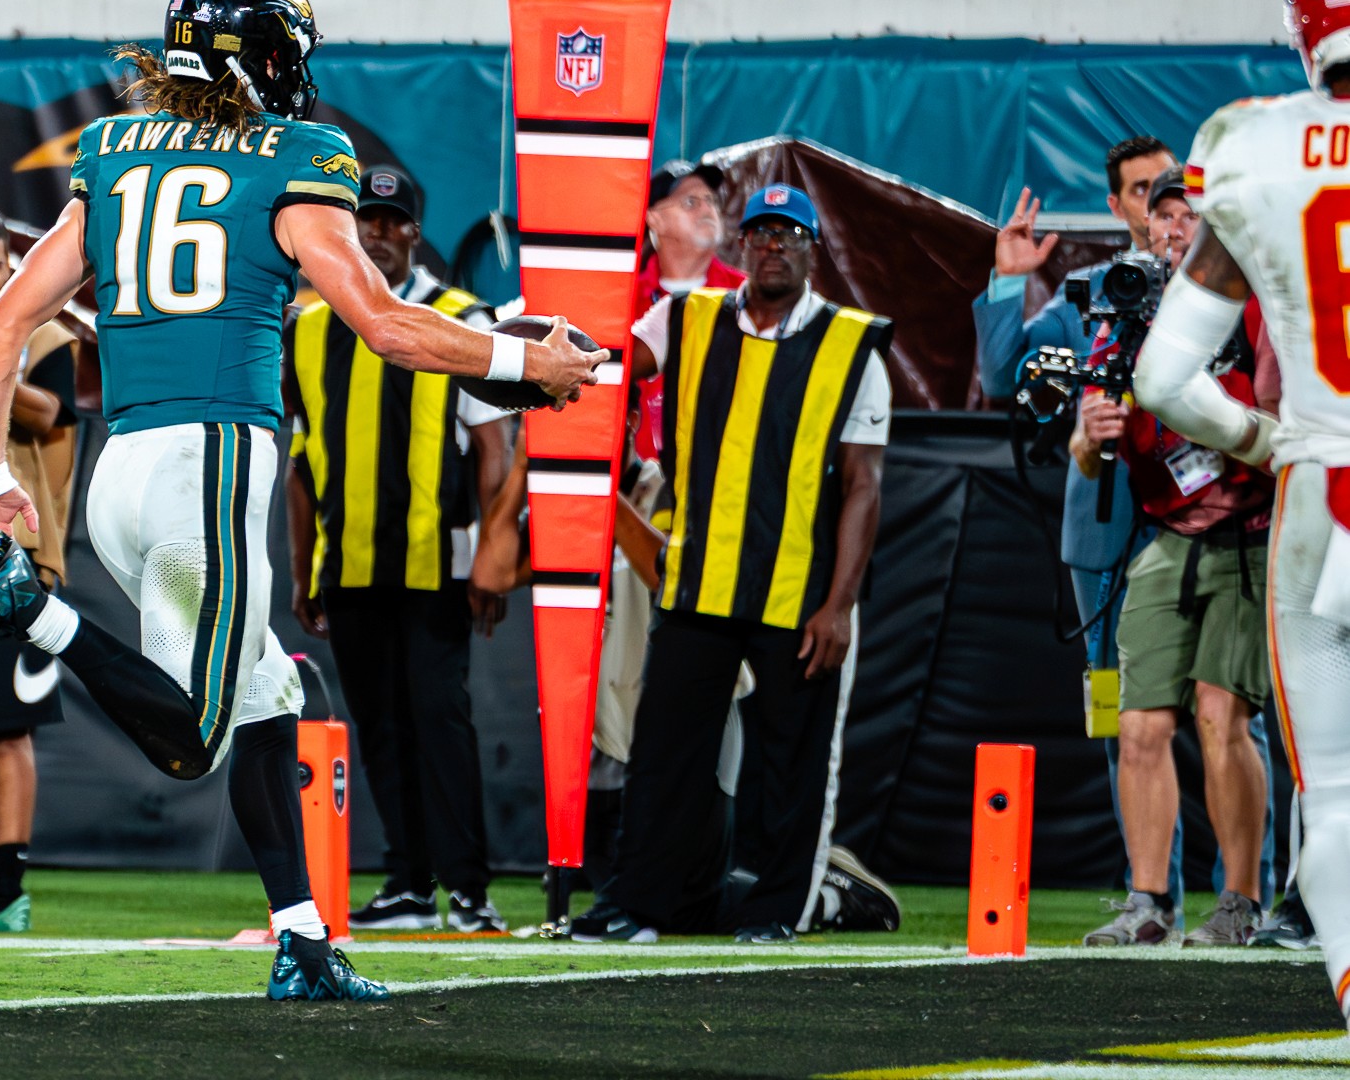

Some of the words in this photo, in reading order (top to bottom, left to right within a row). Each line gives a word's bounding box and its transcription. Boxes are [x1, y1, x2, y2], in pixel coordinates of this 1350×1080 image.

[174, 20, 193, 44] 16
[167, 55, 201, 71] JAGUARS
[559, 60, 599, 84] NFL
[97, 119, 283, 162] LAWRENCE
[109, 164, 232, 317] 16
